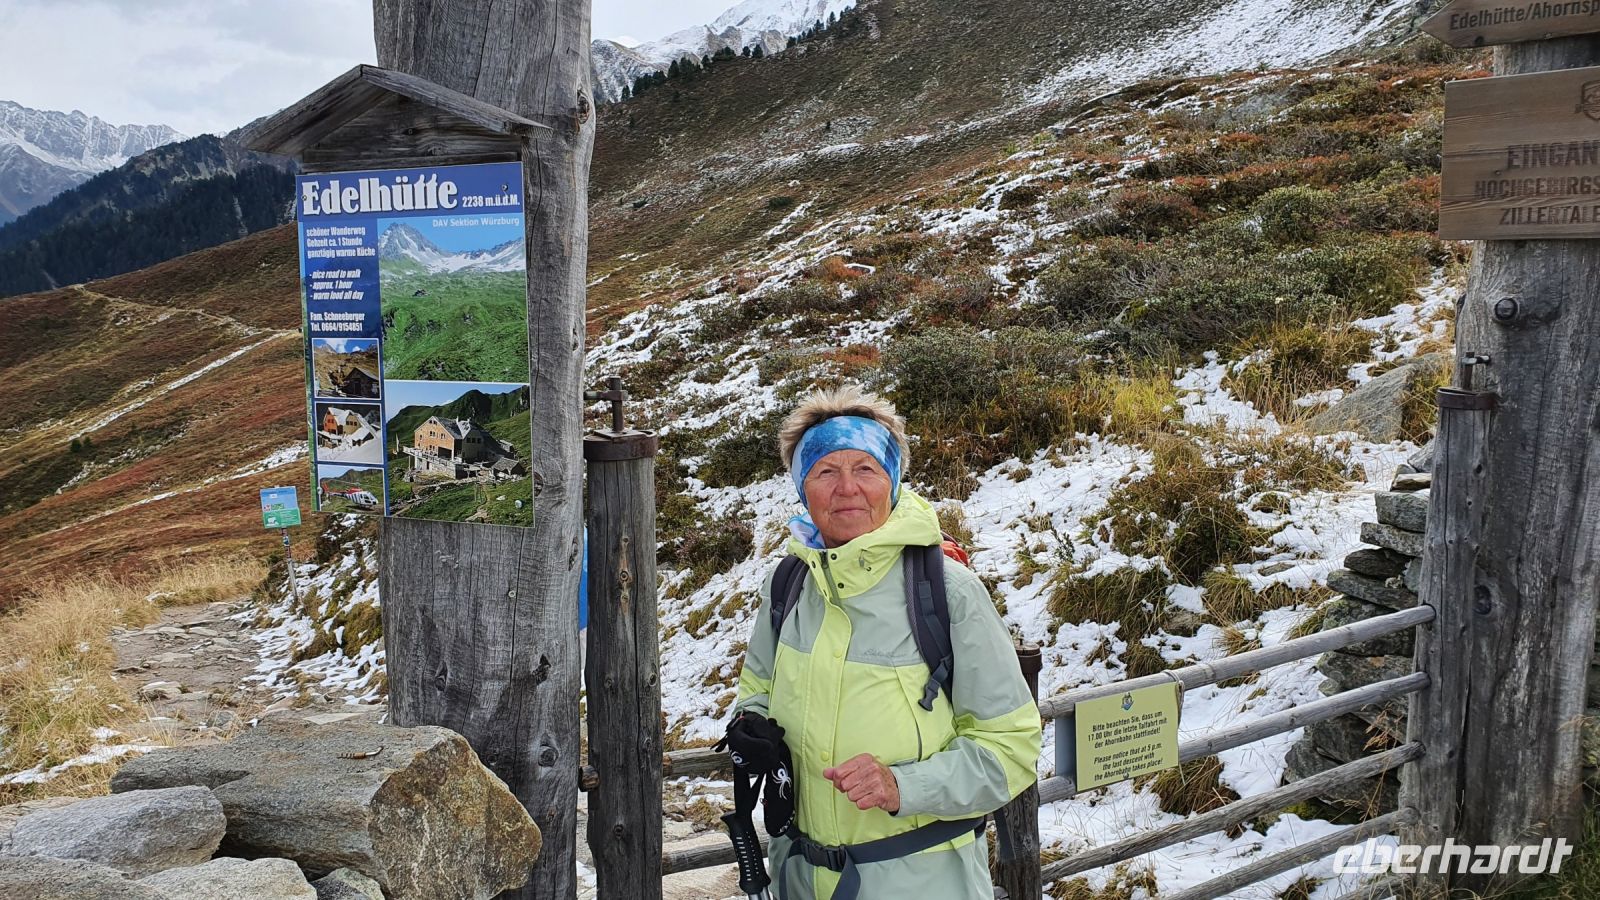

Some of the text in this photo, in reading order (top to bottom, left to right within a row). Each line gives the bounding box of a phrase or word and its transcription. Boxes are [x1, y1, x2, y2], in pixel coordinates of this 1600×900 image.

[302, 174, 457, 215] Edelhütte
[462, 196, 484, 208] 2238
[432, 216, 520, 227] DAV Sektion Würzburg
[306, 226, 366, 237] schöner Wanderweg
[306, 238, 328, 247] Gehzeit
[328, 239, 337, 247] ca.
[341, 236, 363, 246] Stunde
[307, 247, 376, 259] ganztägig warme Küche
[311, 270, 326, 279] nice
[325, 269, 341, 279] road
[340, 269, 347, 279] to
[346, 268, 362, 278] walk
[338, 280, 353, 289] hour
[313, 291, 330, 300] warm
[343, 290, 353, 300] all
[352, 290, 365, 301] day
[310, 312, 365, 322] Fam. Schneeberger
[310, 322, 321, 332] Tel.
[1092, 723, 1105, 733] Bitte
[1106, 718, 1130, 729] beachten
[1131, 716, 1141, 724] Sie,
[1103, 730, 1113, 738] Uhr
[1113, 728, 1122, 736] die
[1122, 724, 1138, 733] letzte
[1138, 721, 1158, 730] Talfahrt
[1094, 727, 1160, 749] der Ahornbahn stattfindet!
[1093, 755, 1112, 765] Please
[1112, 750, 1129, 761] notice
[1129, 747, 1141, 756] that
[1140, 745, 1147, 753] at
[1102, 752, 1155, 771] the last descent with
[1094, 758, 1163, 782] the Ahornbahn takes place!
